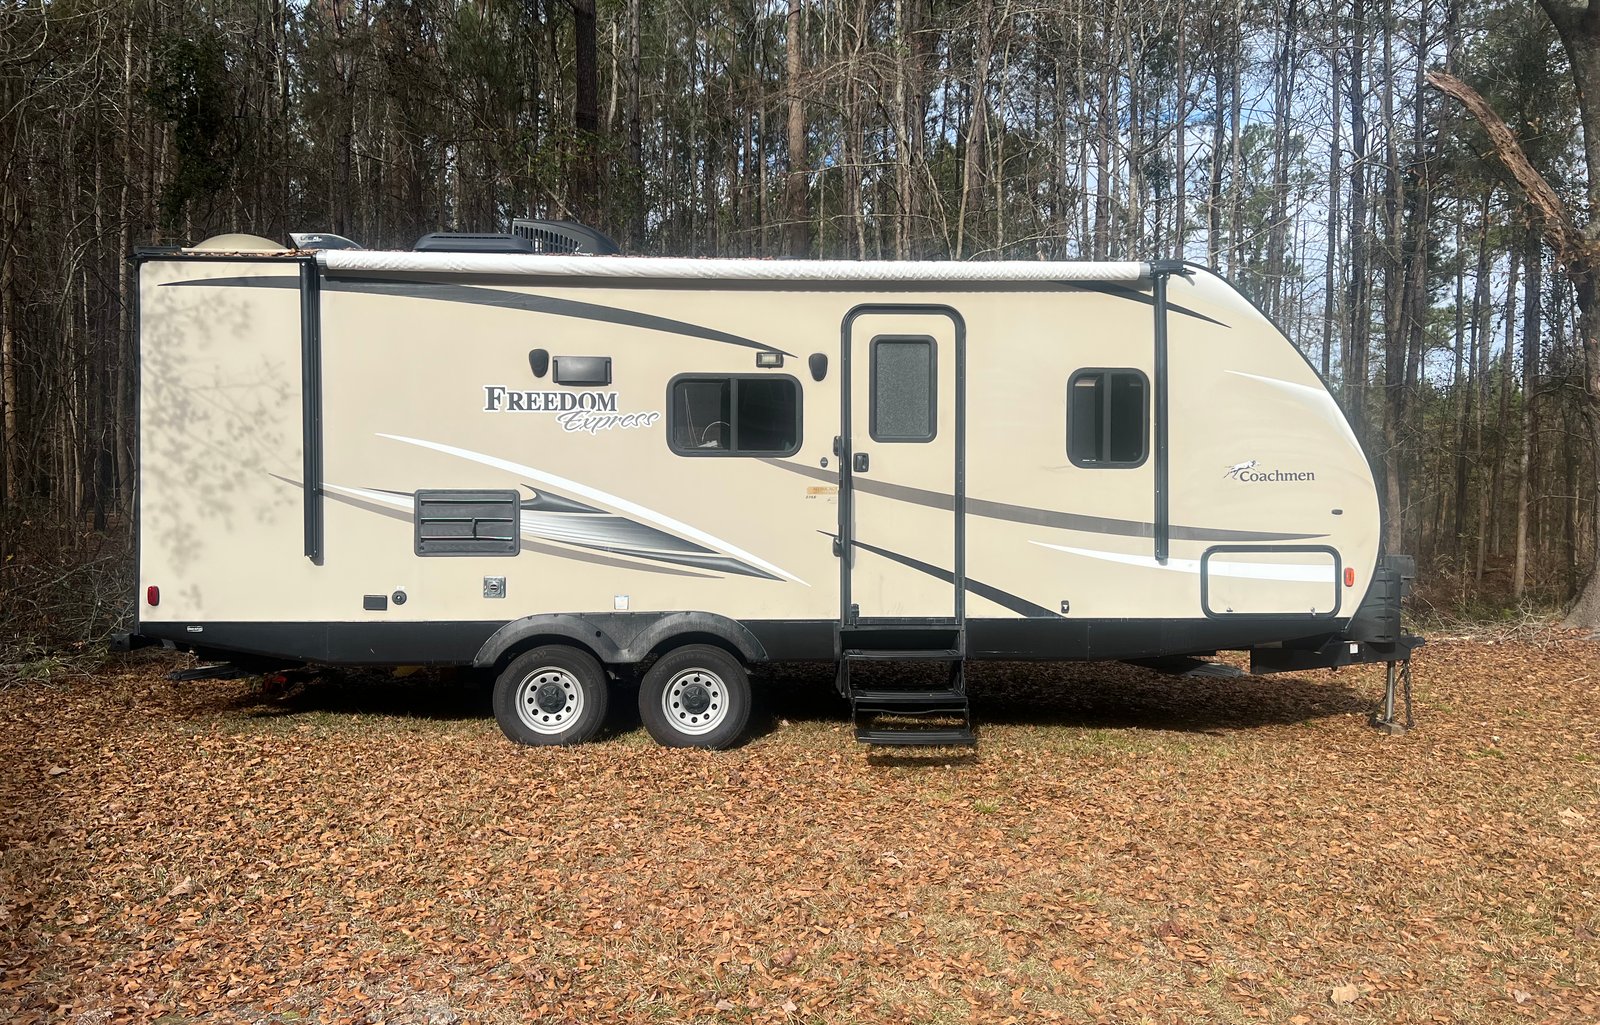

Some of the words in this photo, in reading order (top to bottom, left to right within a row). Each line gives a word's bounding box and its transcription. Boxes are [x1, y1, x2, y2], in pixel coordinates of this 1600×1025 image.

[484, 386, 617, 412] FREEDOM
[556, 410, 660, 433] Express
[1239, 469, 1315, 482] Coachmen
